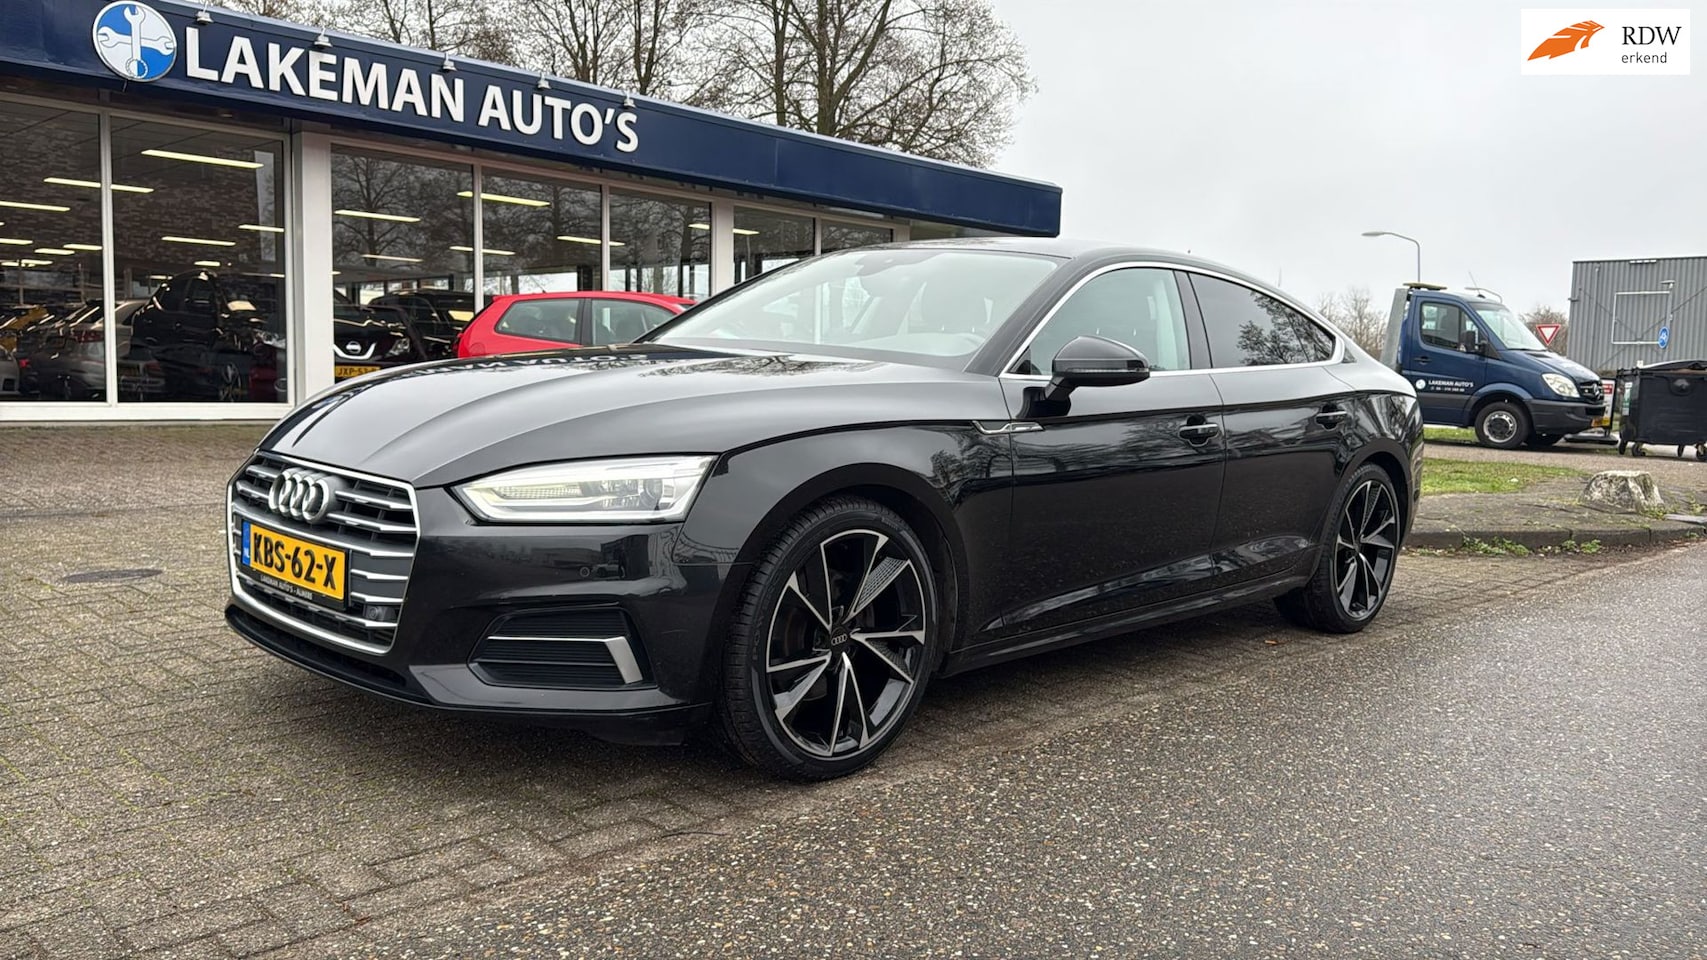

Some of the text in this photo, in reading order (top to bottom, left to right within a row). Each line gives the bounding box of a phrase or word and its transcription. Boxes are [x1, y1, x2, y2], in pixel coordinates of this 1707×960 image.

[185, 27, 639, 153] LAKEMAN AUTO'S
[254, 532, 337, 591] KBS-62-X
